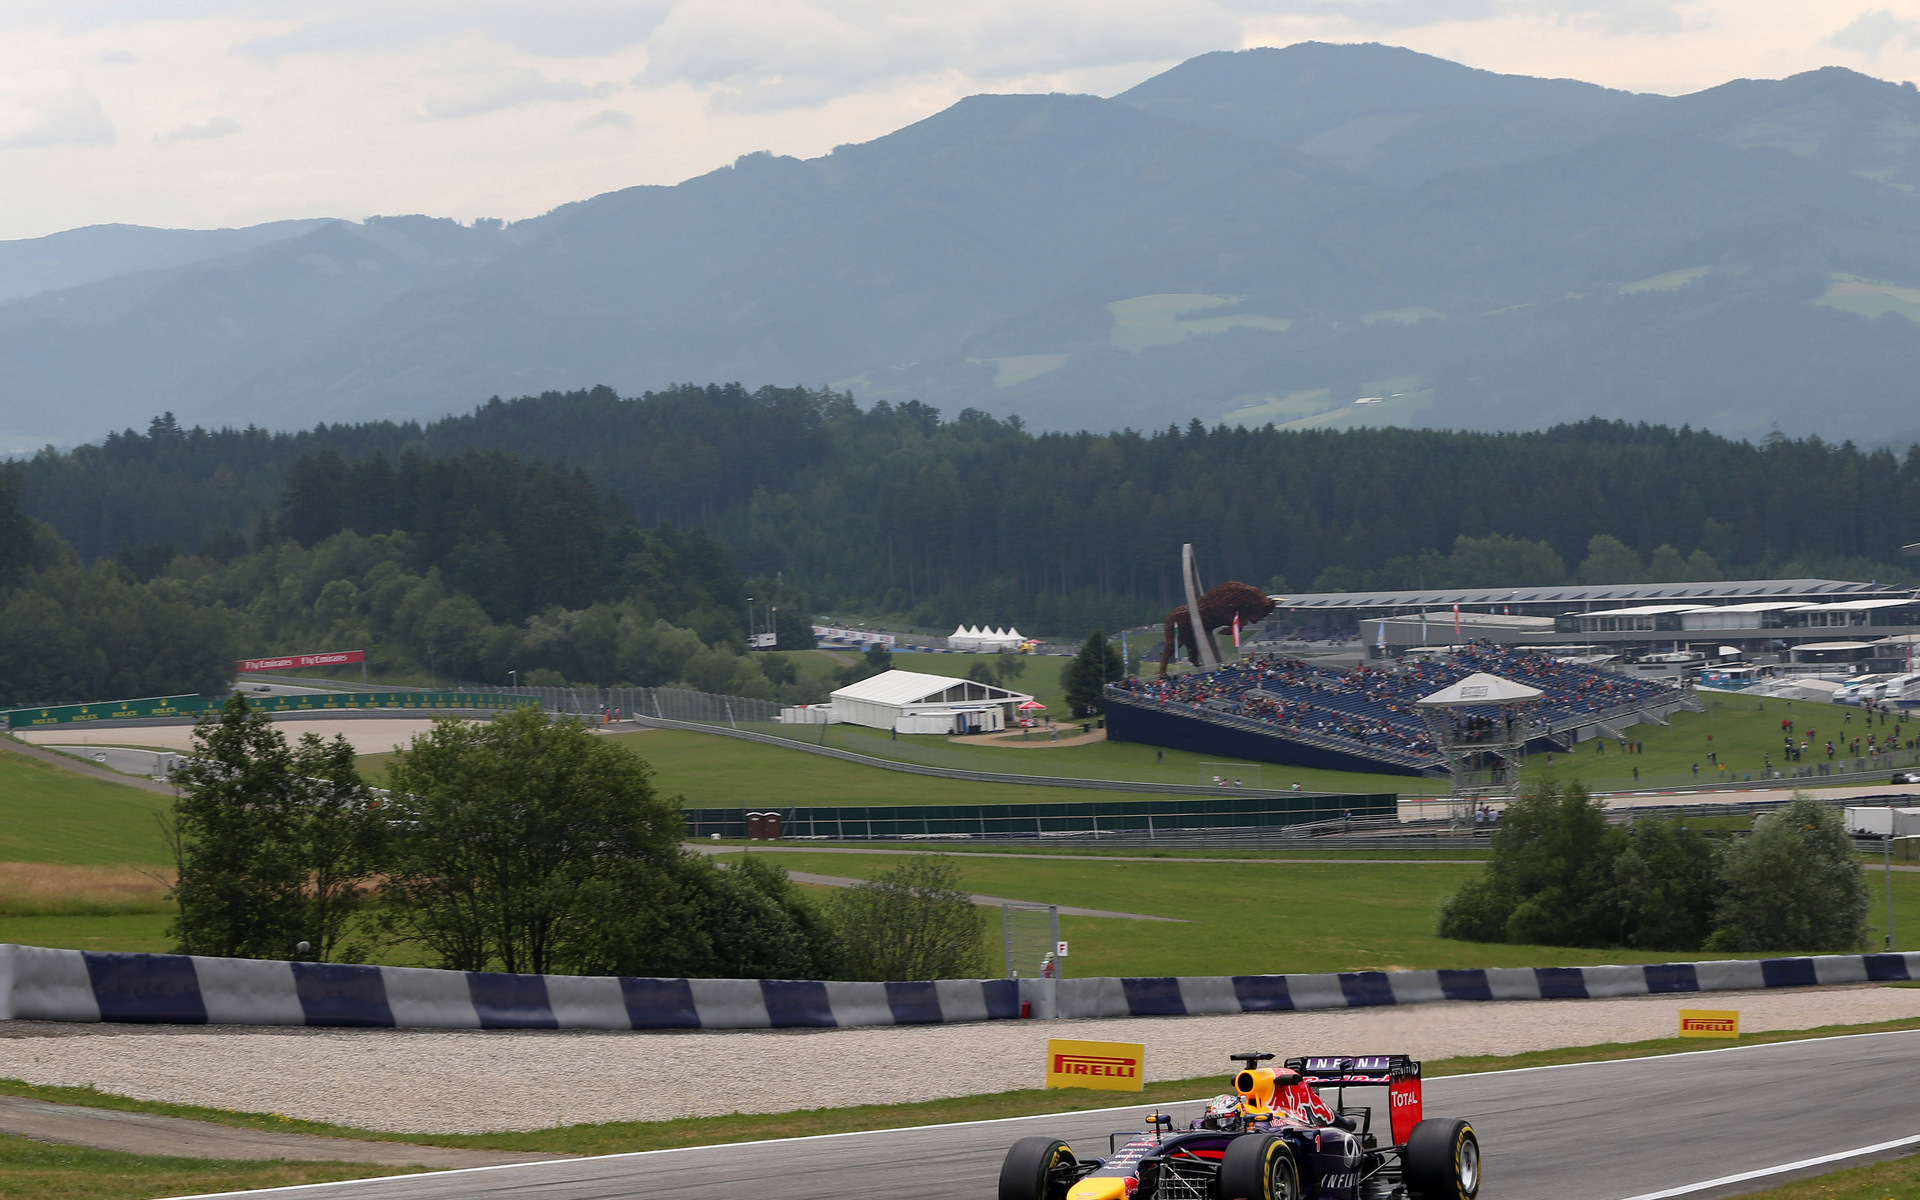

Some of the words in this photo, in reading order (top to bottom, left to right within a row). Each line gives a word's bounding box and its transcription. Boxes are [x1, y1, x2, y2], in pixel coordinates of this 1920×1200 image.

[245, 661, 259, 669] Fly
[260, 659, 293, 668] Emirates
[301, 656, 315, 665] Fly
[315, 654, 348, 664] Emirates
[112, 710, 138, 718] ROLEX
[152, 706, 177, 714] ROLEX
[32, 717, 59, 725] ROLEX
[1683, 1018, 1735, 1031] PIRELLI
[1053, 1054, 1136, 1078] PIRELLI
[1391, 1091, 1418, 1108] TOTAL
[1315, 1134, 1320, 1152] 1
